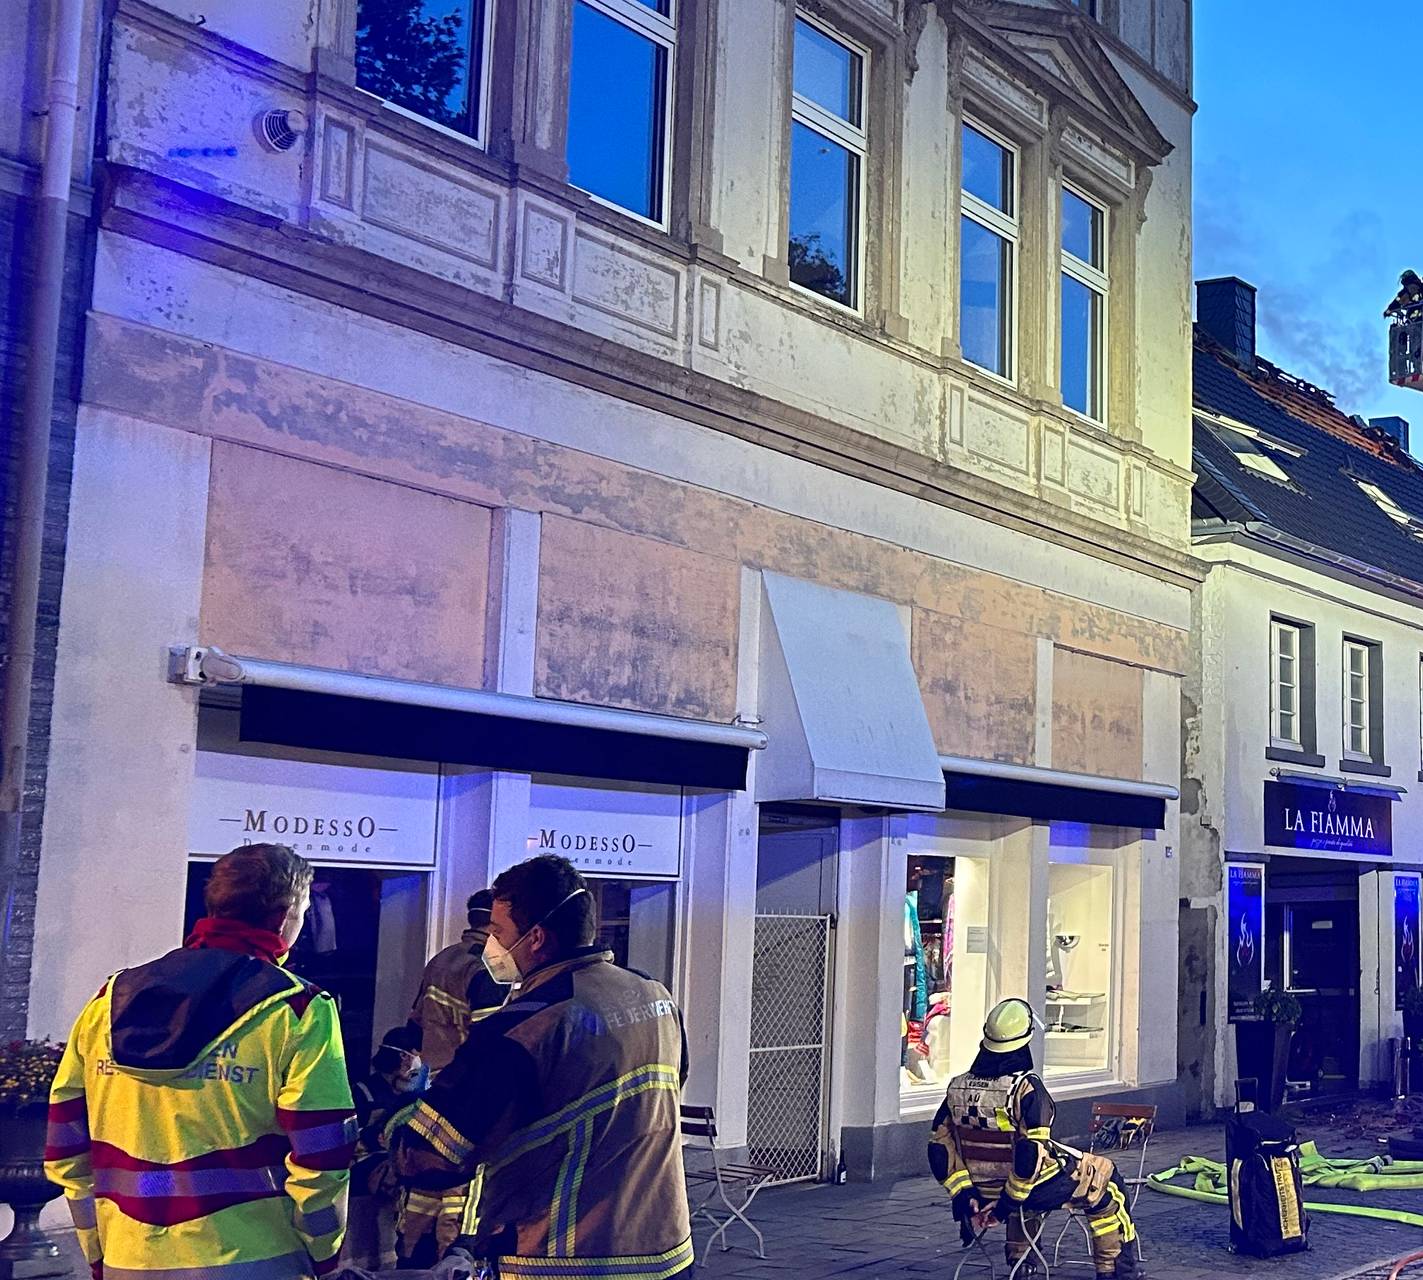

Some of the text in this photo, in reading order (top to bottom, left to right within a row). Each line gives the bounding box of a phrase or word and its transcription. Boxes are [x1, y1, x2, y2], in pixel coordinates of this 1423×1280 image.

[1285, 808, 1375, 839] LA FIAMMA
[243, 837, 371, 853] Denmode
[604, 998, 676, 1034] FEUERWEH
